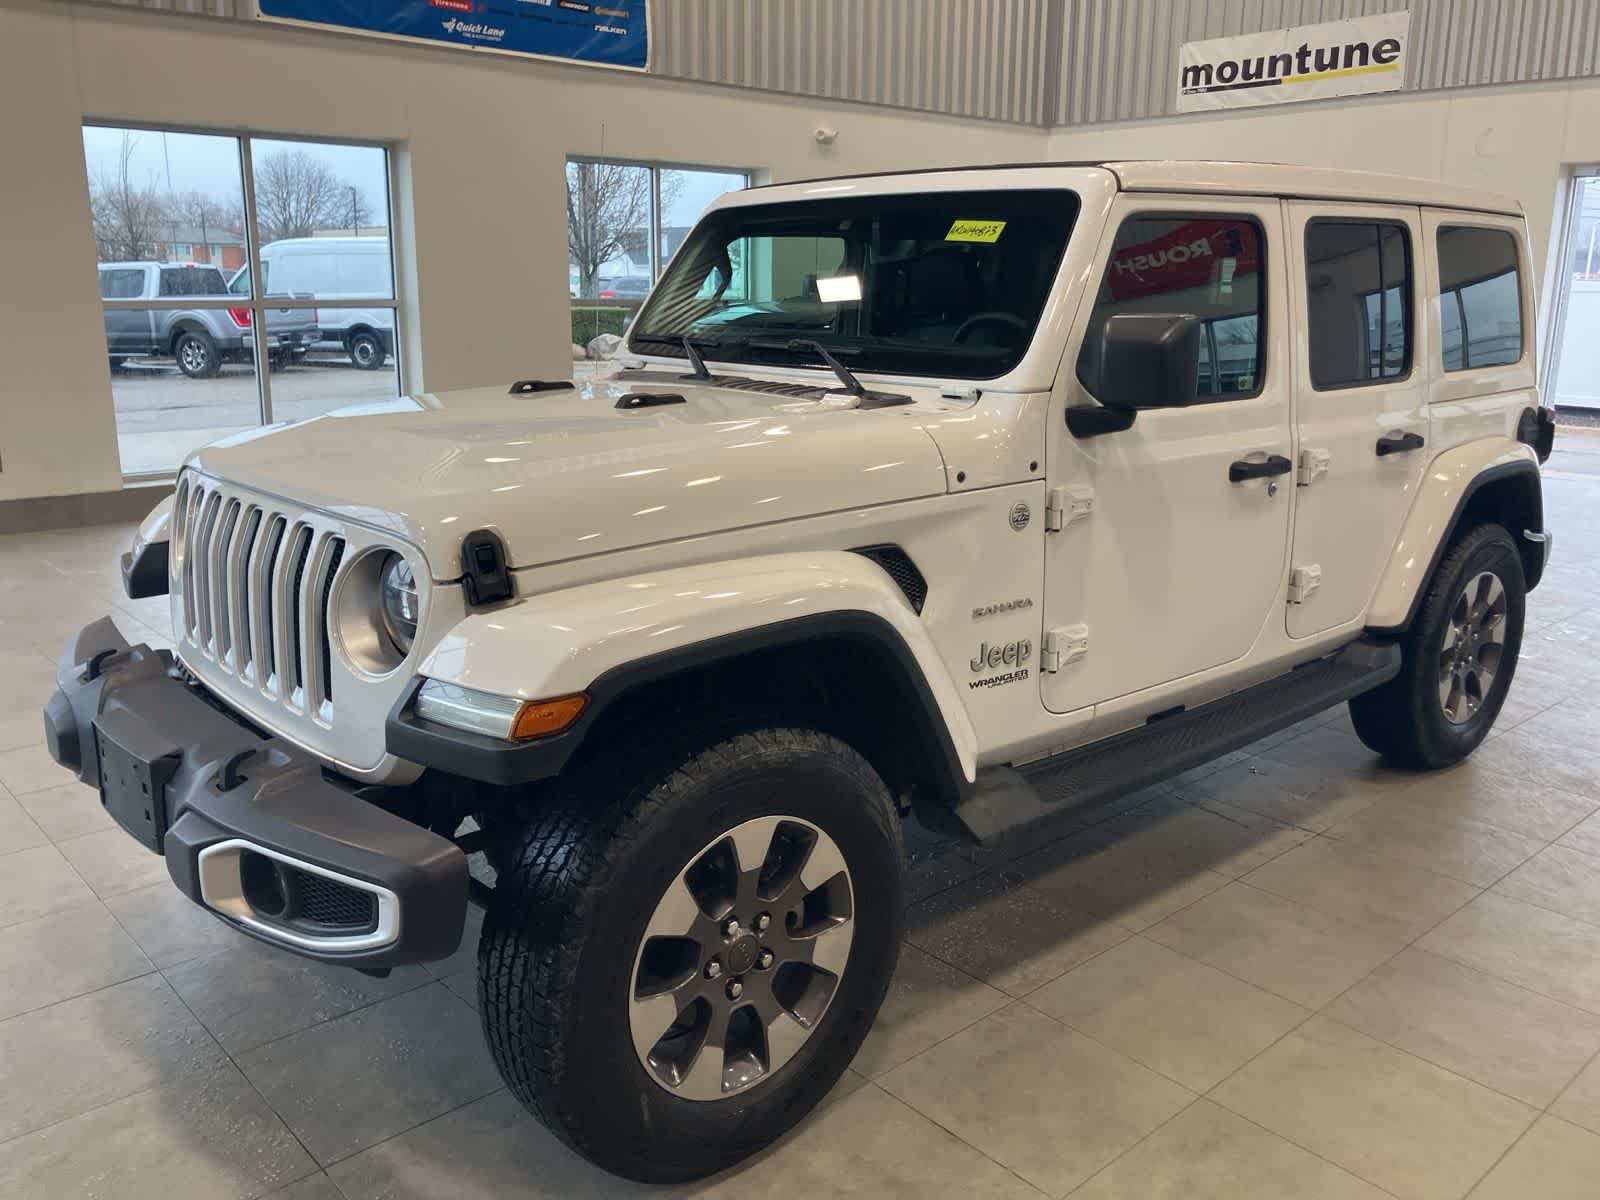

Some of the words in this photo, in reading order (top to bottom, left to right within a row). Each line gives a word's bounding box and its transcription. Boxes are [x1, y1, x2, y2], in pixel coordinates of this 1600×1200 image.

[456, 22, 482, 34] Quick
[482, 25, 505, 37] Lane
[1181, 38, 1400, 88] mountune
[970, 640, 1032, 673] Jeep
[969, 669, 1029, 690] WRANGLER
